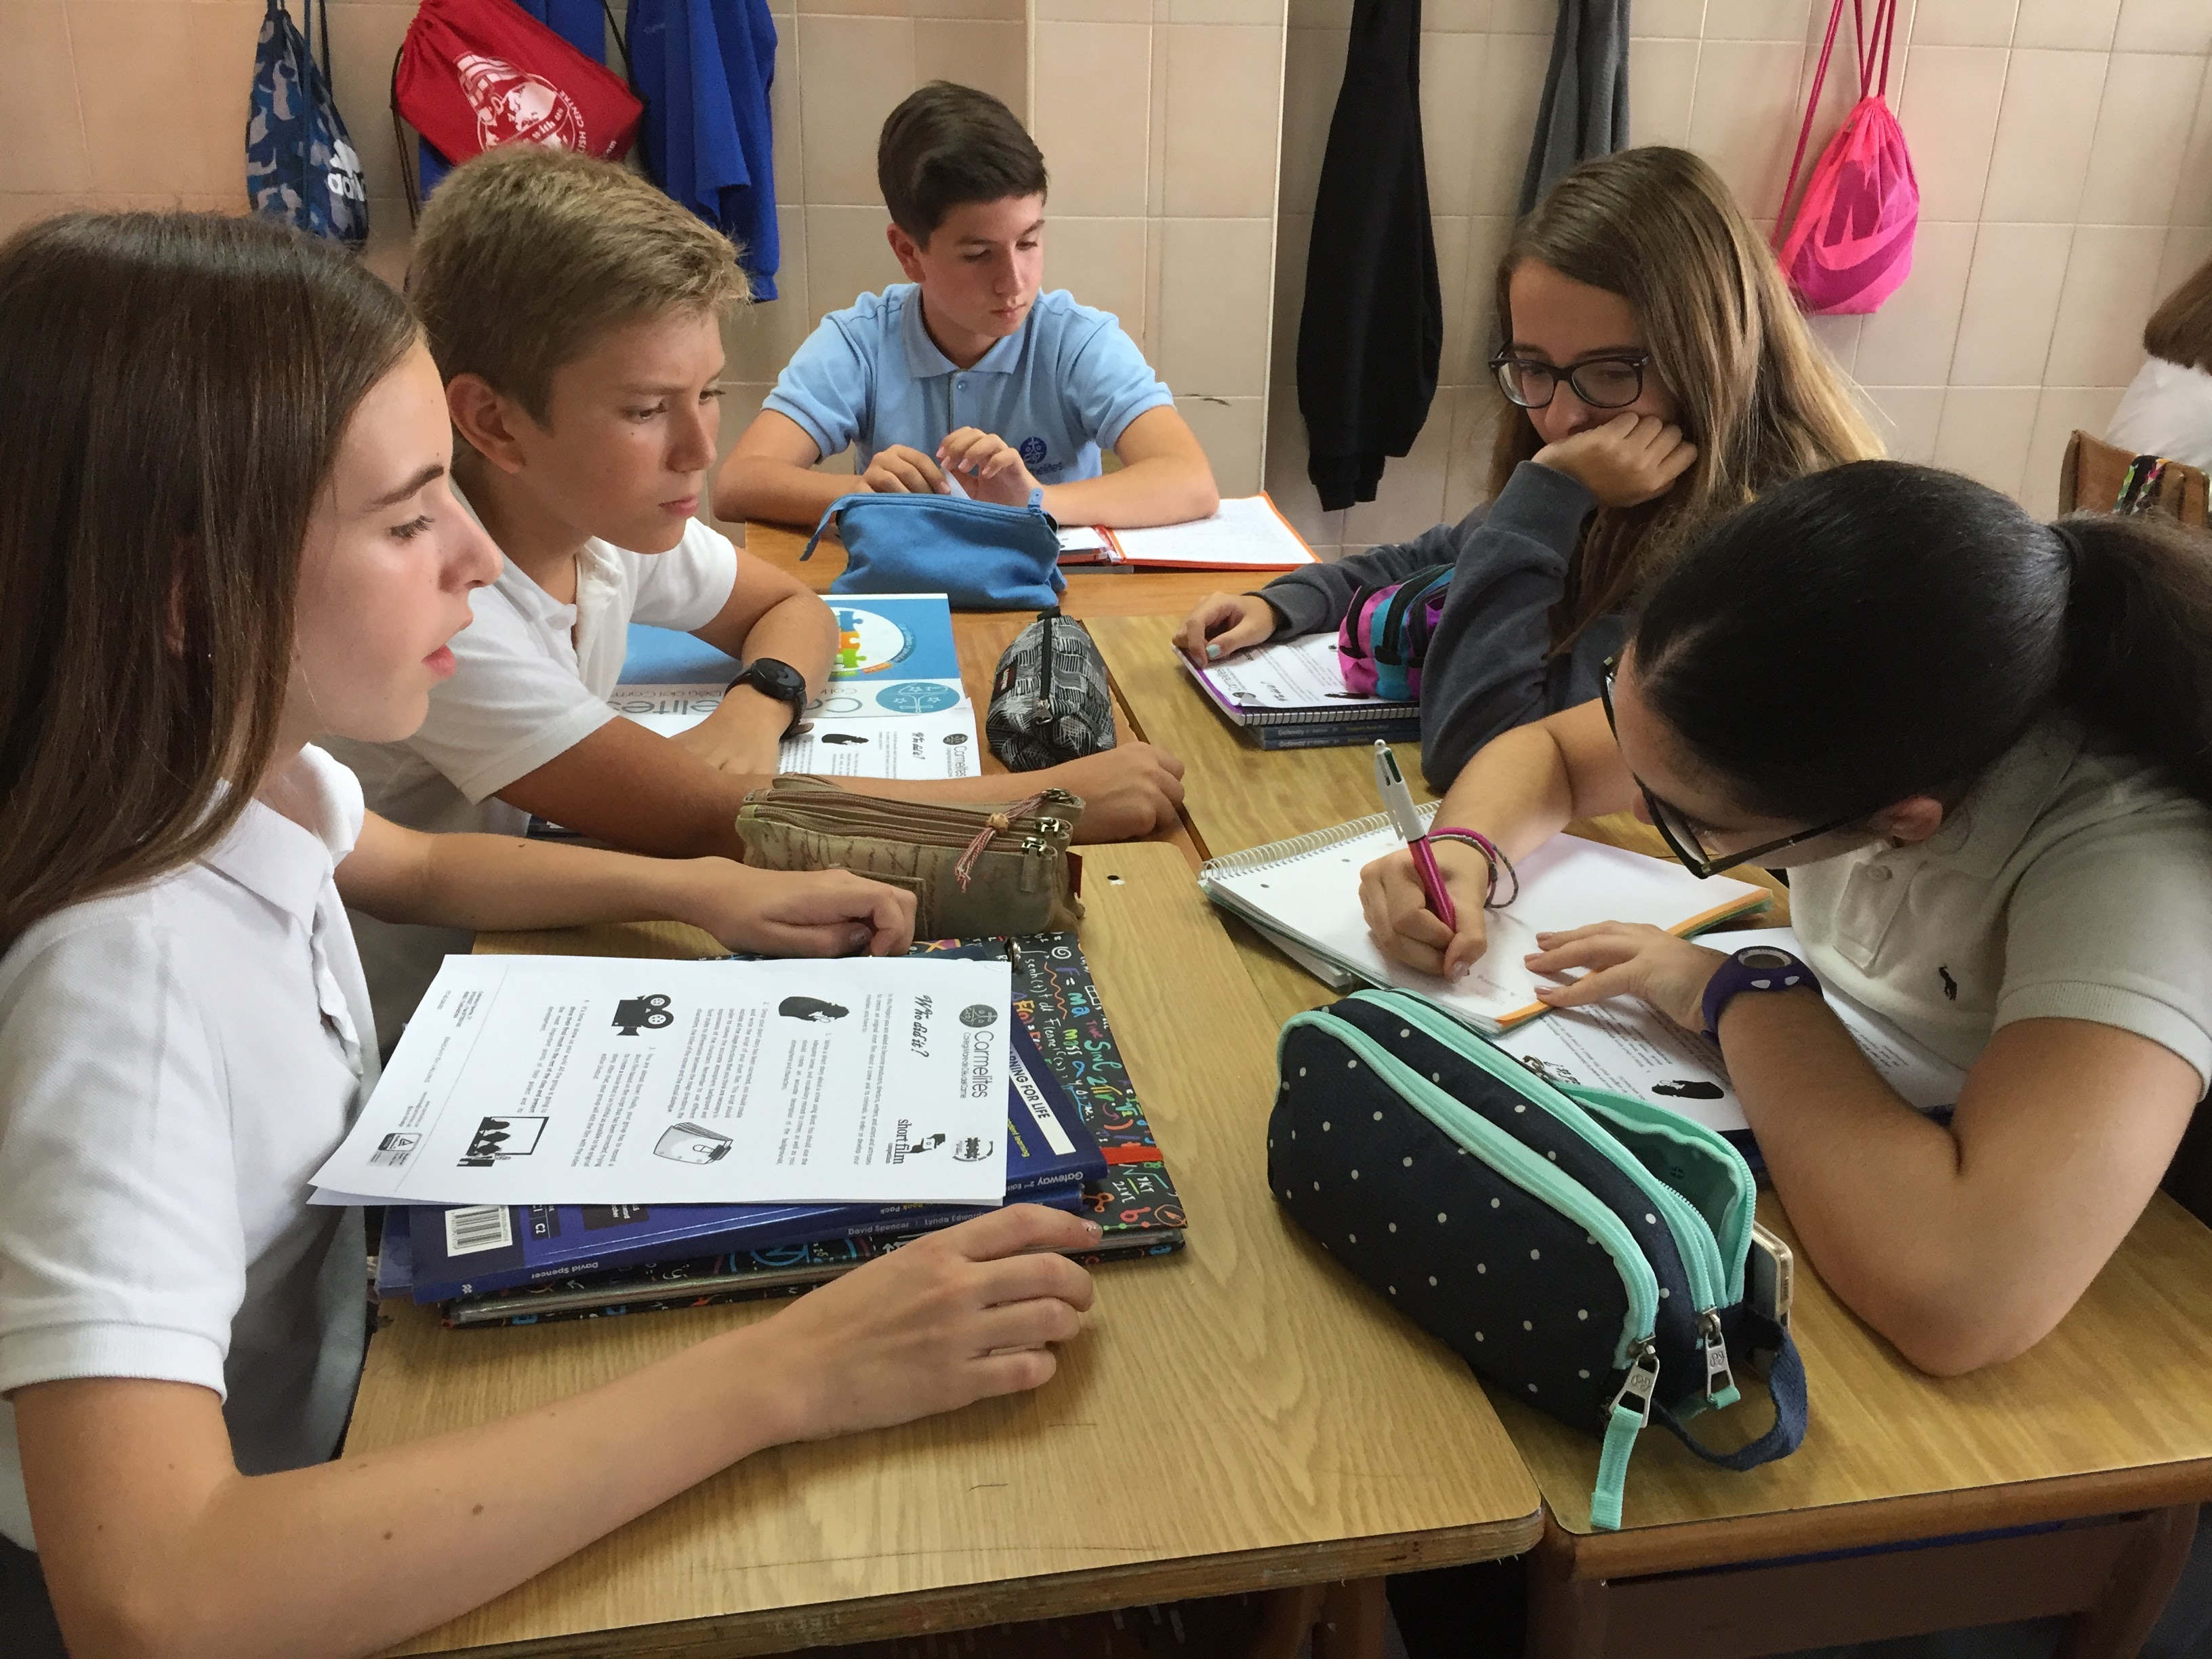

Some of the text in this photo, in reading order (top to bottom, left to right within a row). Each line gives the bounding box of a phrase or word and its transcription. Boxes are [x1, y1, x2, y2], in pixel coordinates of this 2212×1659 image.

[560, 90, 584, 127] CENTRE
[612, 691, 656, 699] Carm
[912, 995, 934, 1020] Who
[911, 1021, 928, 1042] did
[970, 1031, 994, 1098] Carmelites
[1020, 1084, 1039, 1102] FOR
[1031, 1102, 1050, 1119] LIFE
[893, 1119, 912, 1164] short film
[1005, 1183, 1022, 1193] Edit
[1037, 1171, 1084, 1187] Gateway
[880, 1205, 901, 1214] Pack
[535, 1223, 546, 1234] C2
[848, 1226, 873, 1235] David
[875, 1222, 909, 1233] Spencer
[924, 1216, 949, 1226] Lynda
[531, 1261, 598, 1280] David Spencer
